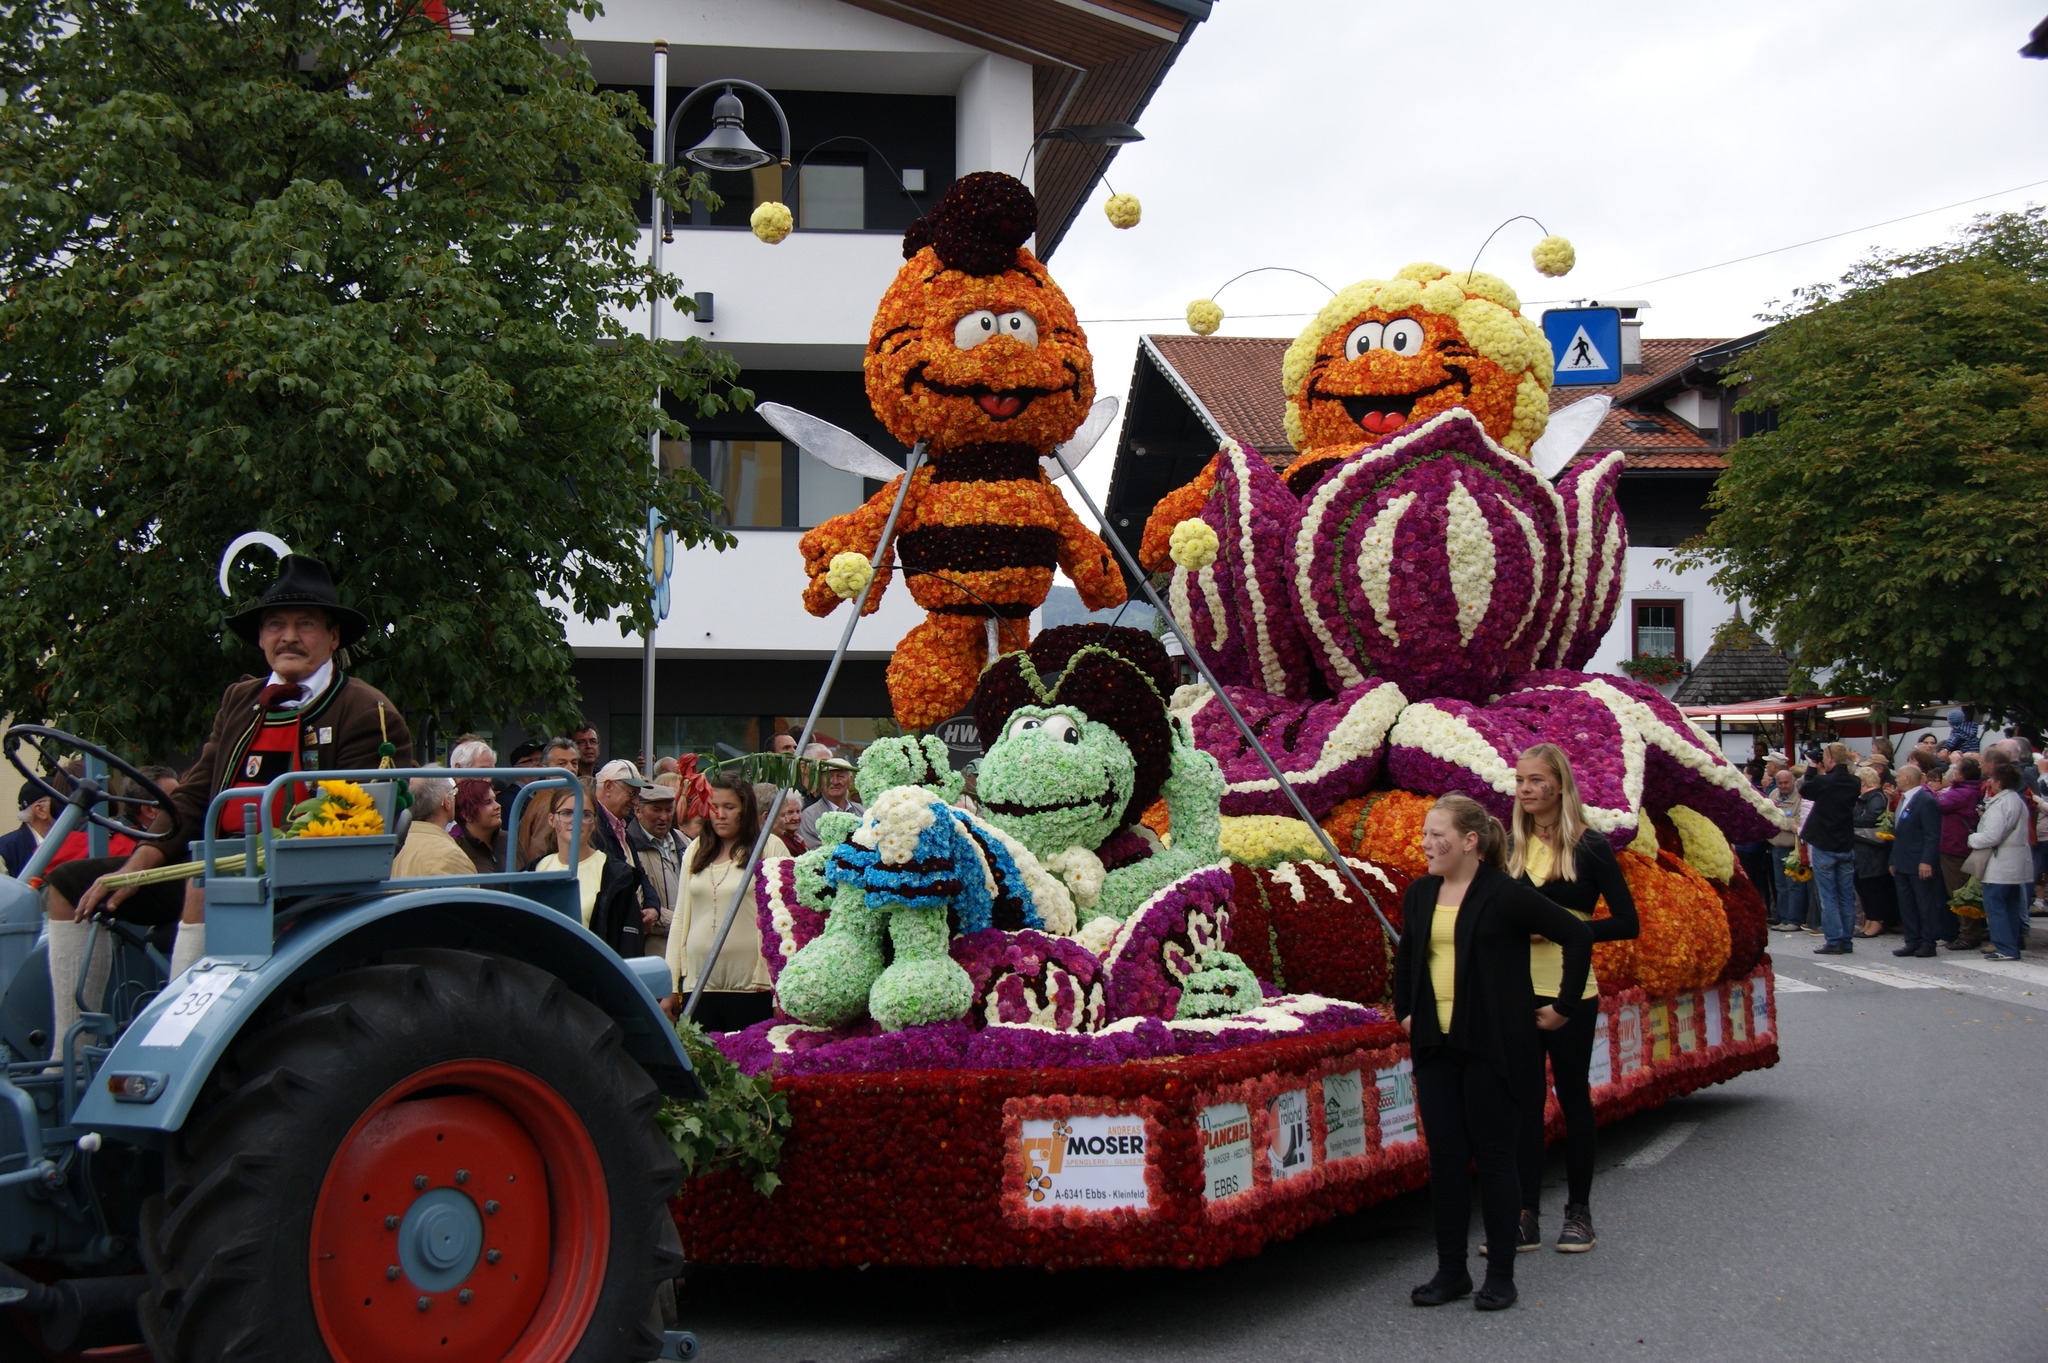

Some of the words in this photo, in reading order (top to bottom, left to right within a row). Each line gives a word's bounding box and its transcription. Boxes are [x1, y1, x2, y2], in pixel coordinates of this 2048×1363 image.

[944, 724, 981, 743] HW
[173, 992, 213, 1016] 39
[1107, 1125, 1141, 1135] ANDREAS
[1201, 1121, 1250, 1154] PLANCHEL
[1067, 1135, 1144, 1155] MOSER
[1213, 1151, 1231, 1166] WASSER
[1055, 1188, 1083, 1200] A-6341
[1085, 1188, 1107, 1200] Ebbs
[1113, 1189, 1145, 1199] Kleinfeld
[1214, 1175, 1239, 1198] EBBS
